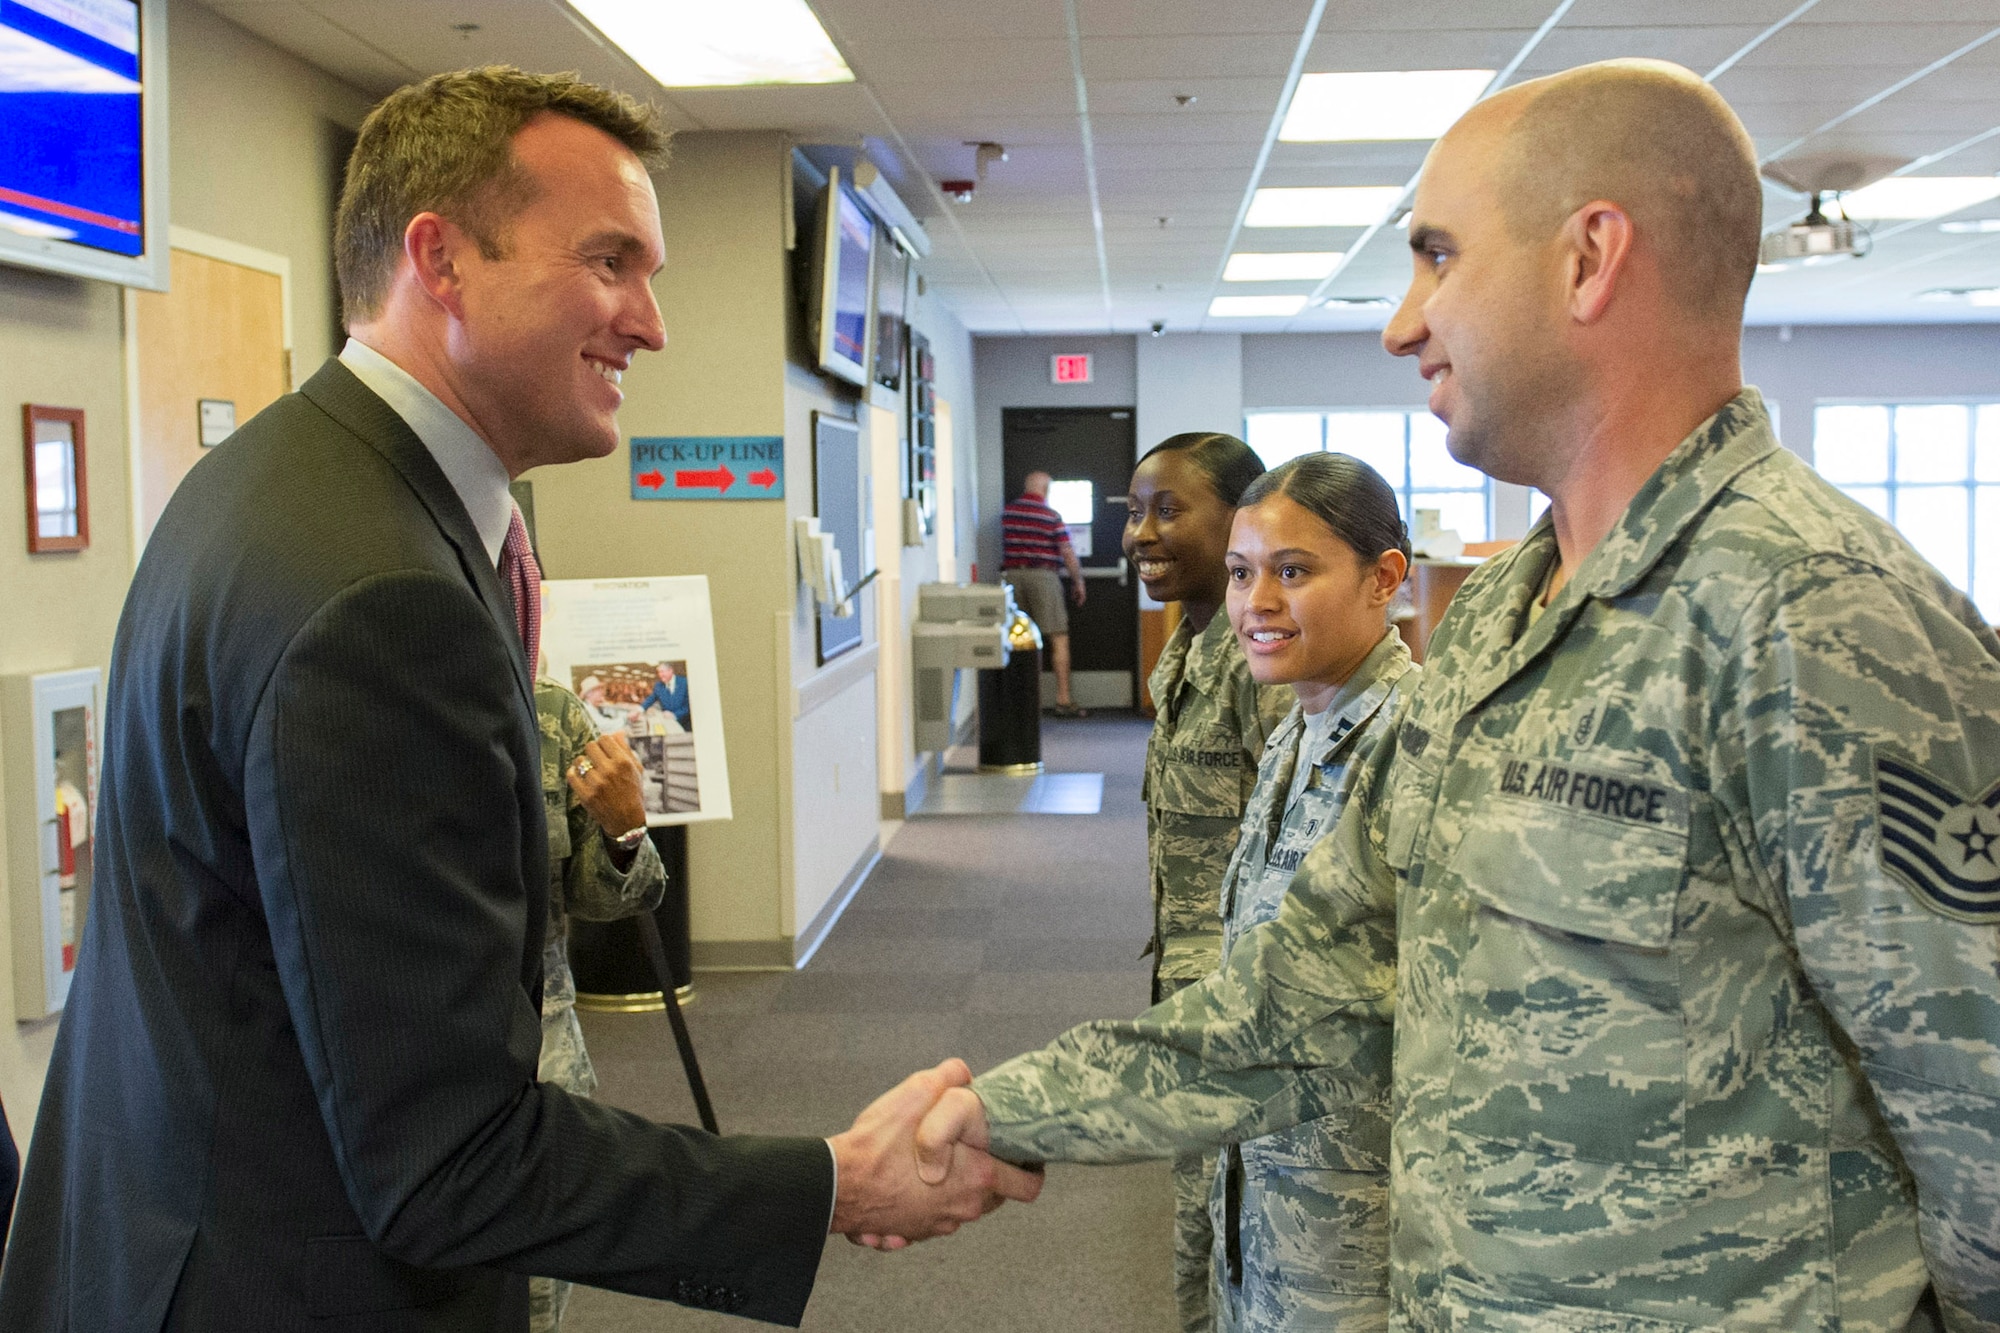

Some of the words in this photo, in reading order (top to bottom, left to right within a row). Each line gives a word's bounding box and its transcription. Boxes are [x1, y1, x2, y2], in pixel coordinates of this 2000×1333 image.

[1057, 356, 1088, 381] EXIT
[636, 443, 724, 462] PICK-UP
[730, 442, 779, 460] LINE
[1197, 750, 1241, 767] FORCE
[1529, 764, 1570, 804] AIR
[1567, 772, 1667, 823] FORCE
[1281, 849, 1299, 871] AIR
